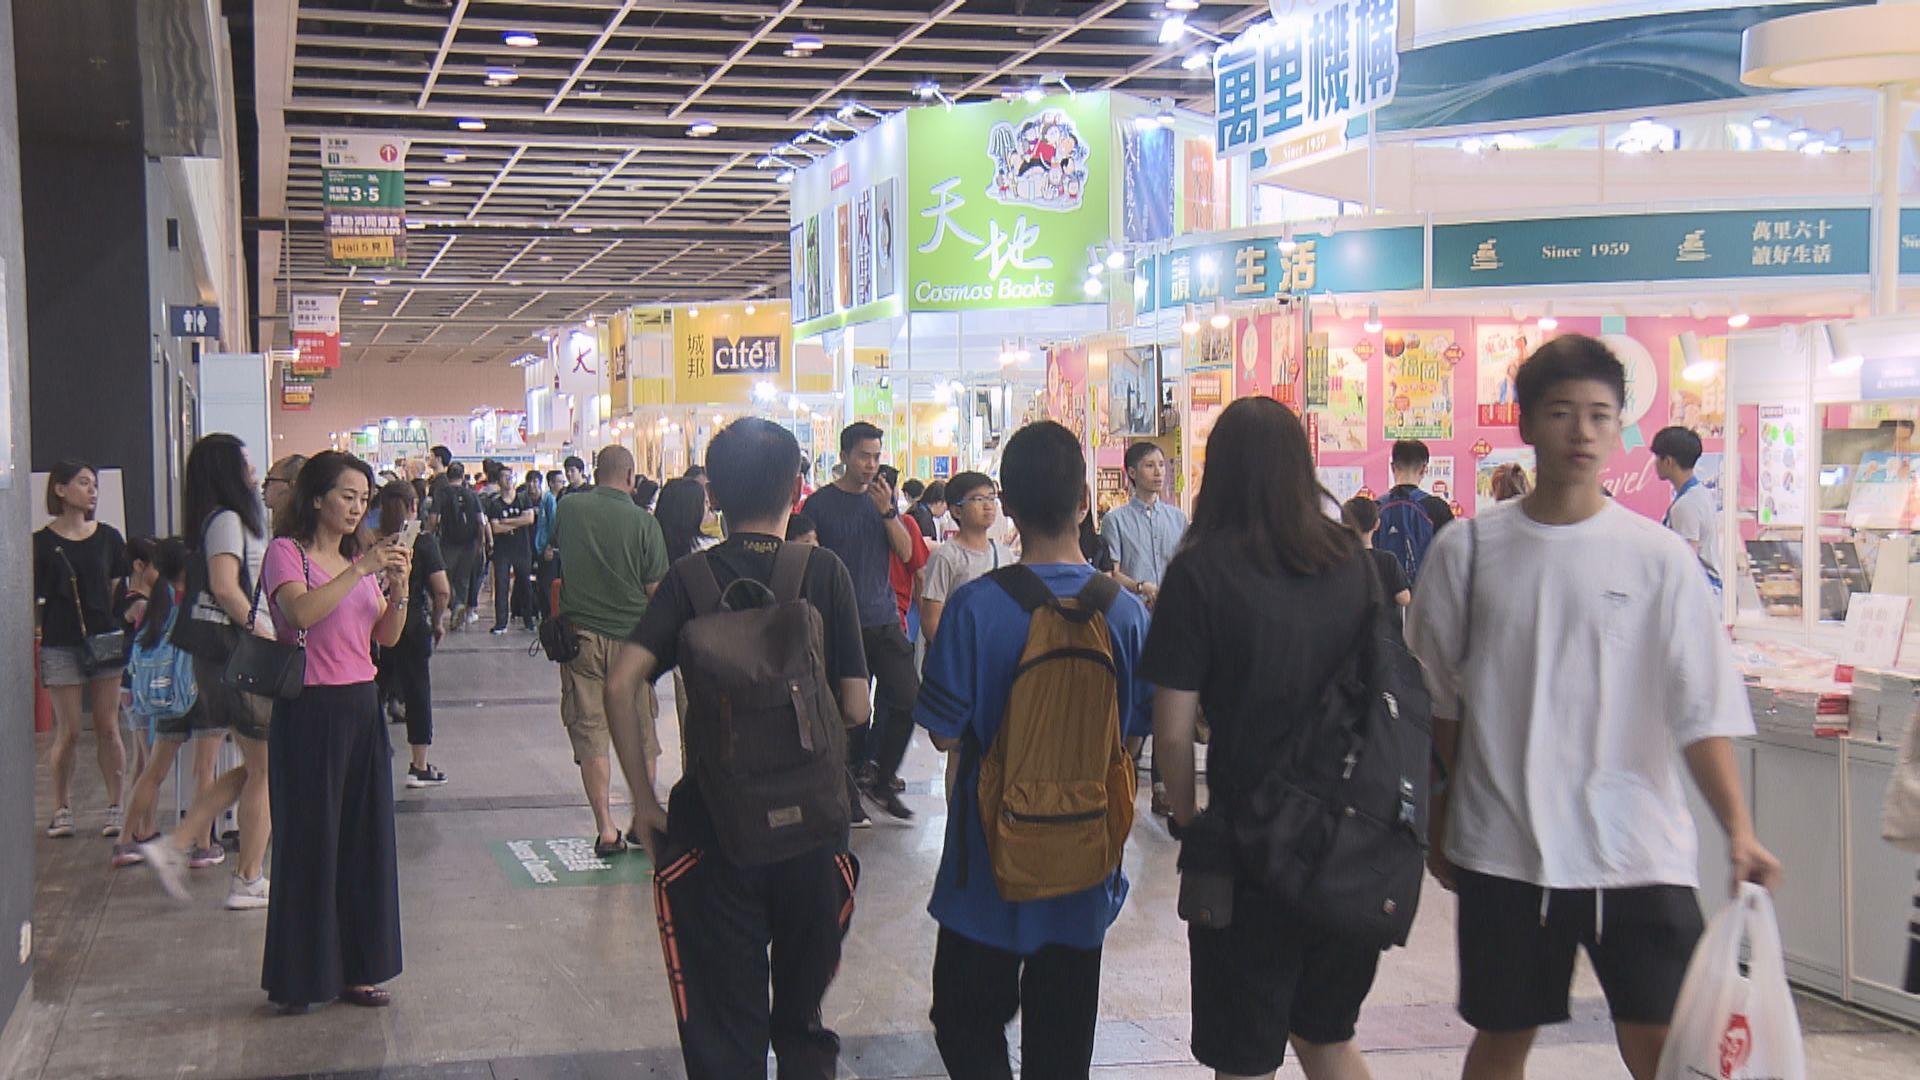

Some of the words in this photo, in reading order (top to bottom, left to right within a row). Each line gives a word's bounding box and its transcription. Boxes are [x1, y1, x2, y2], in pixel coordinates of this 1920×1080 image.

[1217, 0, 1396, 153] 萬里機構
[918, 176, 1053, 280] 天地
[1752, 218, 1832, 241] 萬里六十
[1541, 243, 1581, 260] Since
[1591, 241, 1630, 257] 1959
[914, 280, 993, 303] Cosmos
[998, 275, 1055, 301] Books
[687, 333, 705, 379] 城邦
